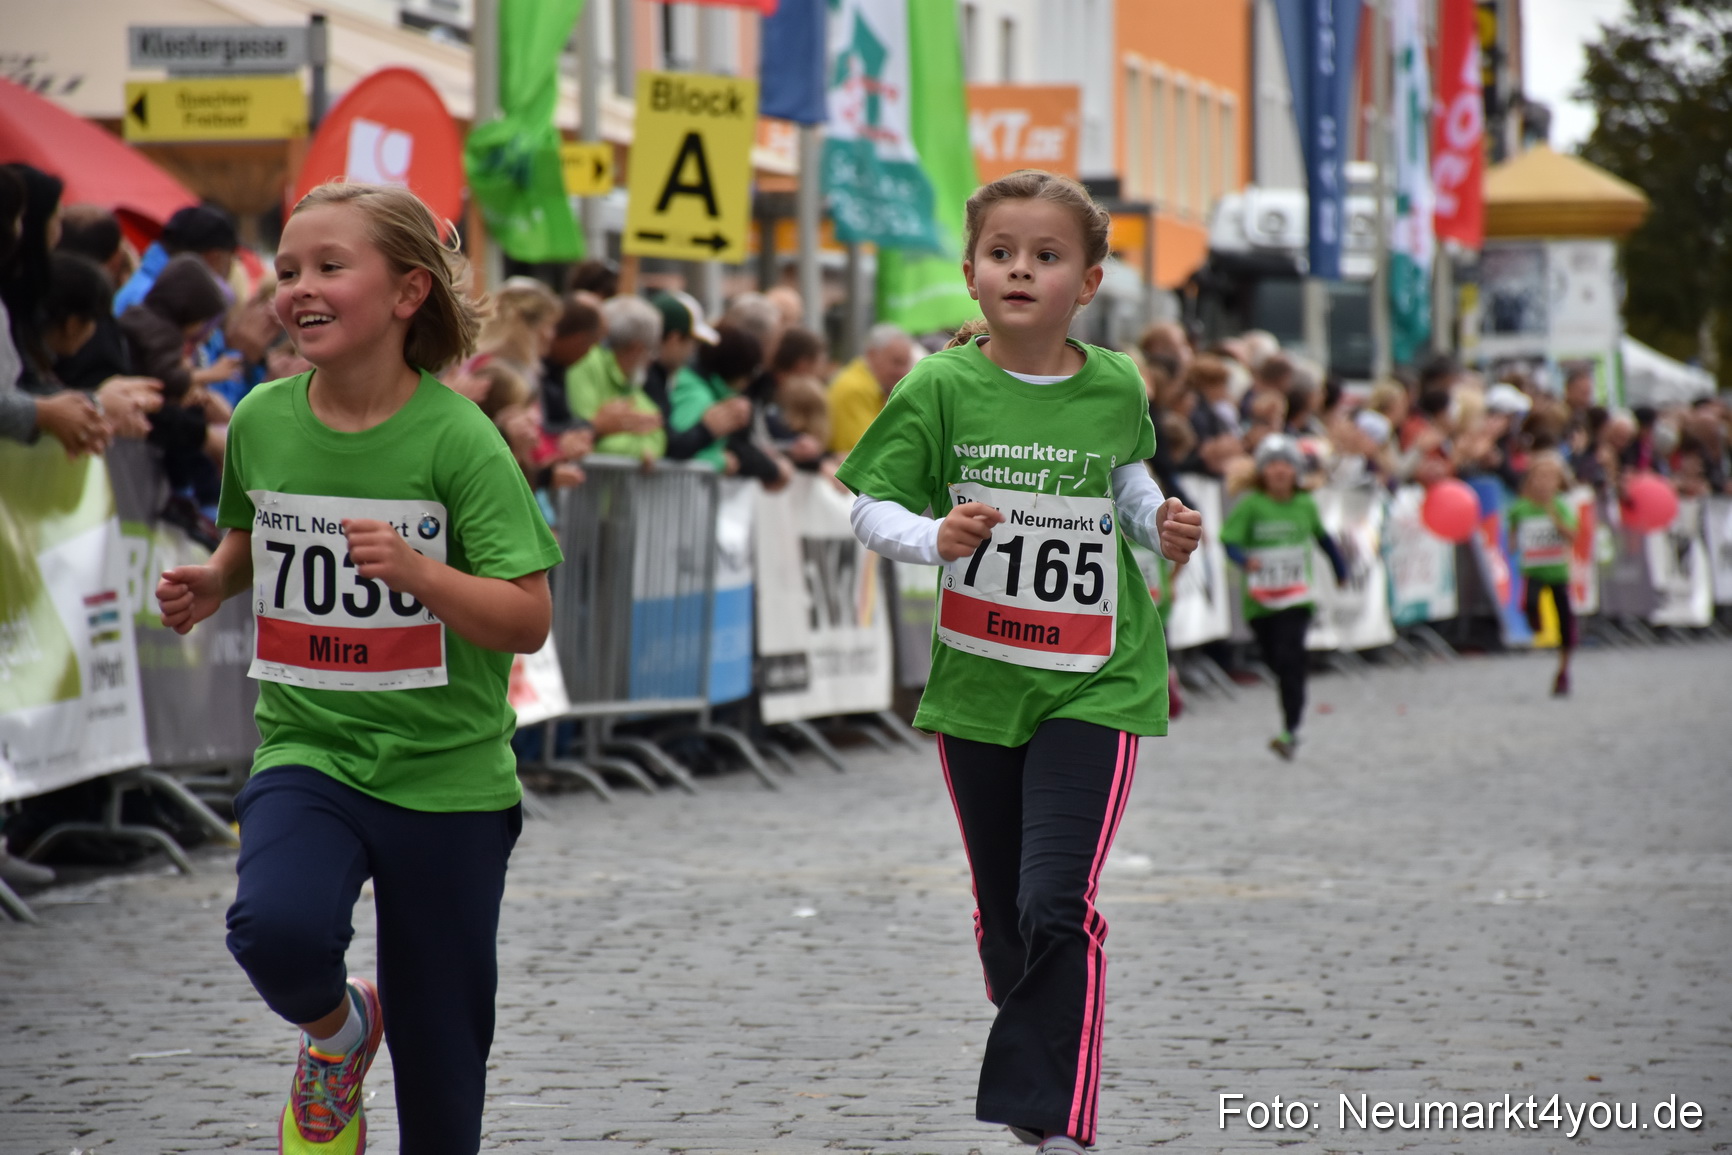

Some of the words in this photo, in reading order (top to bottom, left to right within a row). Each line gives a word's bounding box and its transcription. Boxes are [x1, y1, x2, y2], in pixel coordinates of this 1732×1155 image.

[137, 31, 288, 66] Klostergasse
[652, 78, 743, 118] Block
[655, 131, 720, 219] A
[953, 443, 1077, 463] Neumarkter
[256, 508, 306, 533] PARTL
[1010, 509, 1094, 531] Neumarkt
[964, 535, 1104, 605] 7165
[987, 611, 1060, 645] Emma
[310, 635, 368, 664] Mira
